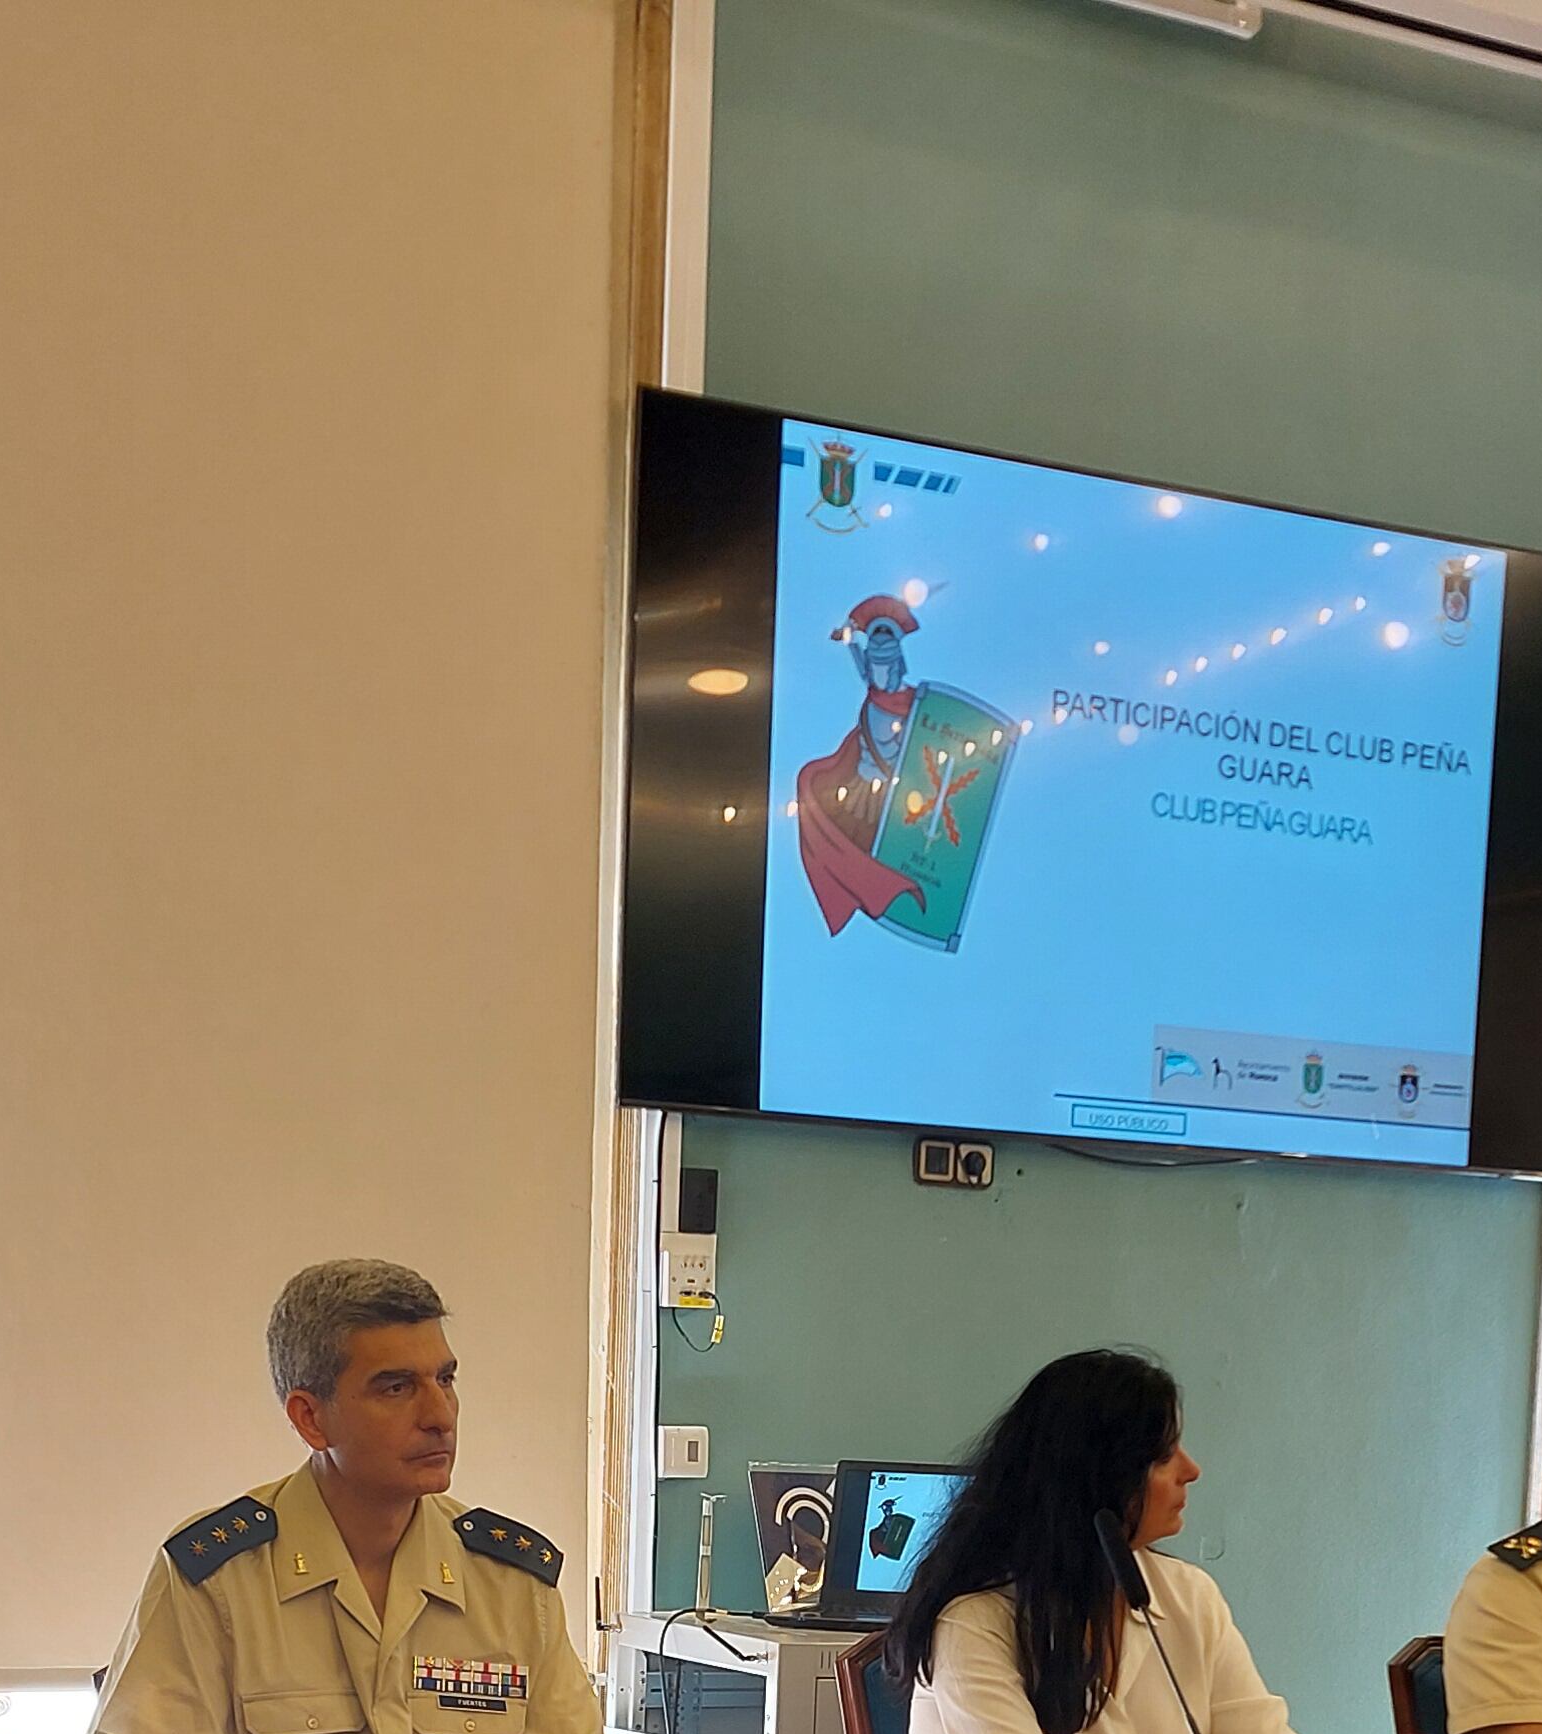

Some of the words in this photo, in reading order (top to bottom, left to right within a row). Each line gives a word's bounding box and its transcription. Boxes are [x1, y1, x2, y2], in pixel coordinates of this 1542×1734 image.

[1051, 688, 1260, 745] PARTICIPACIÓN
[1269, 721, 1319, 754] DEL
[1325, 731, 1395, 764] CLUB
[1401, 740, 1471, 776] PEÑA
[1217, 754, 1314, 790] GUARA
[1151, 791, 1217, 825] CLUB
[1288, 810, 1374, 846] GUARA
